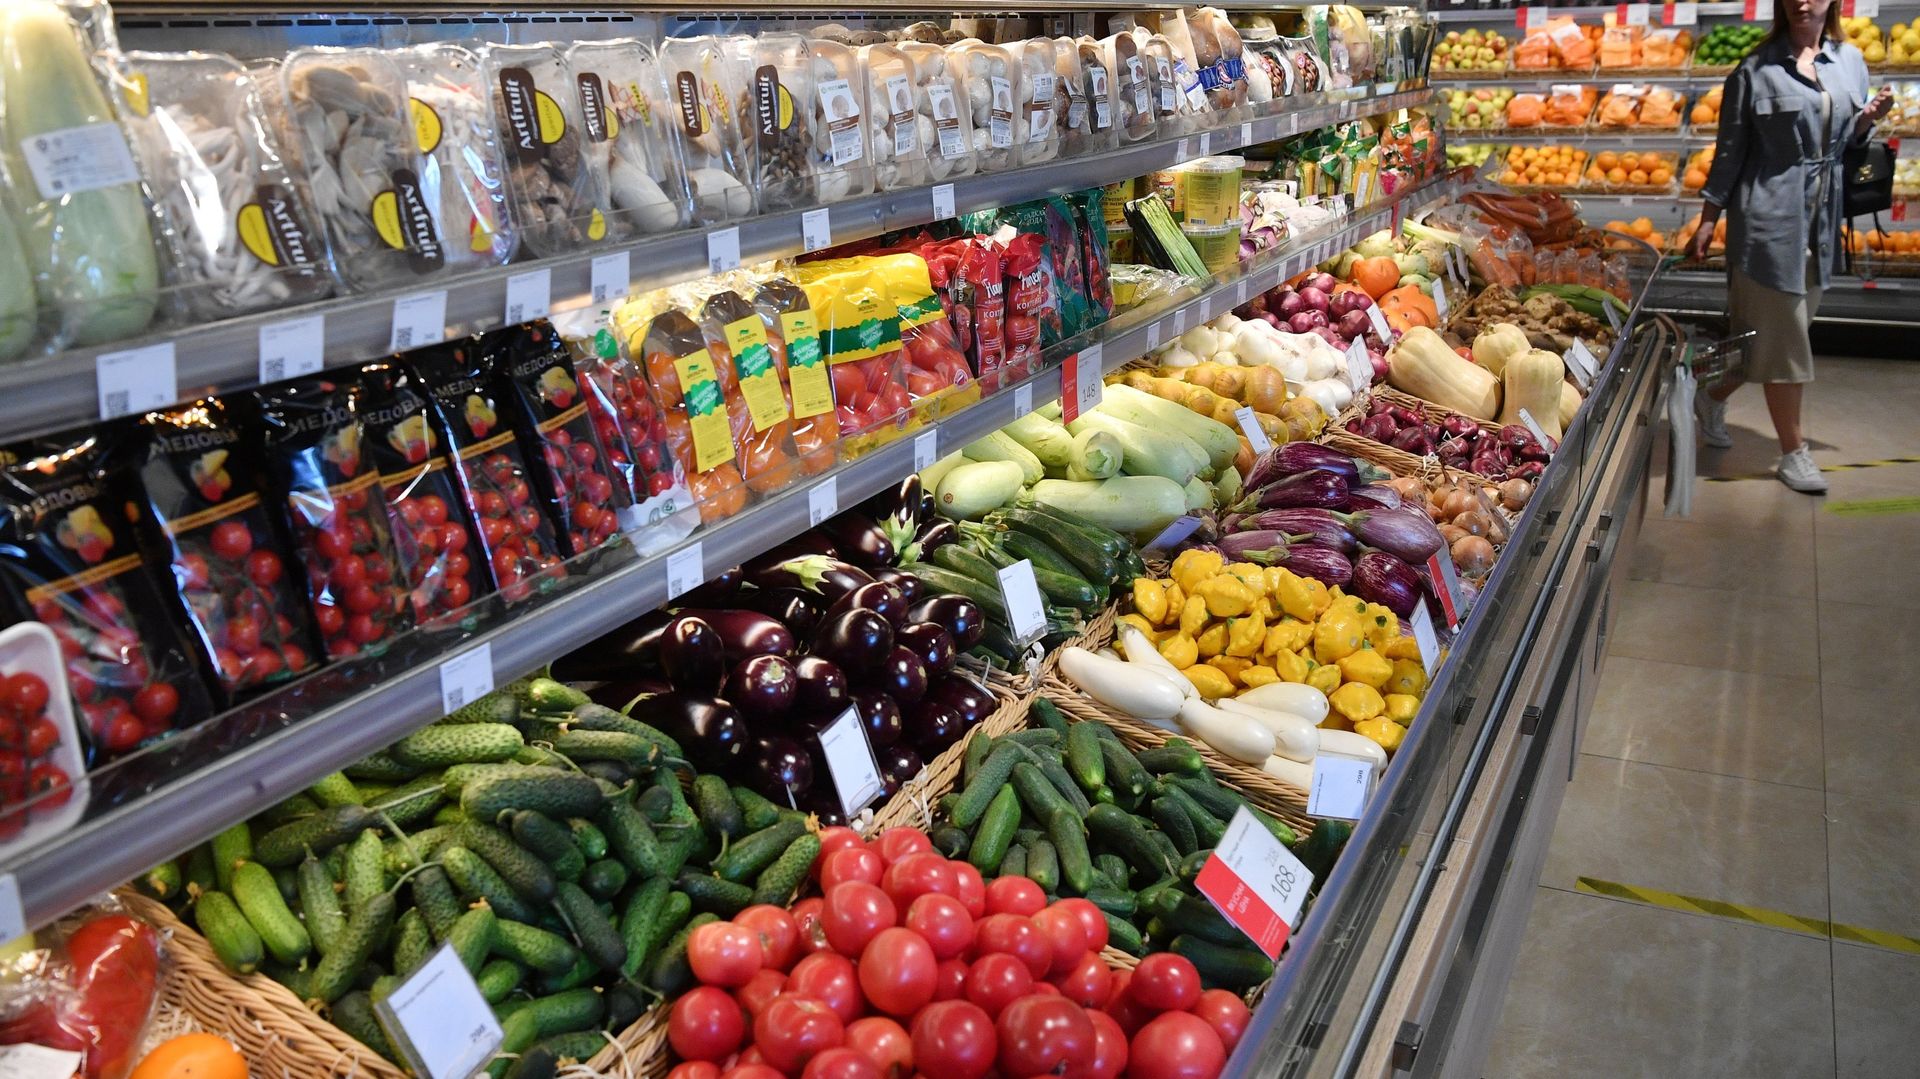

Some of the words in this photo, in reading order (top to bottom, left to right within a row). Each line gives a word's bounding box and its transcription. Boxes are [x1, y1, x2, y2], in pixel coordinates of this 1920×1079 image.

[506, 78, 535, 149] Artfruit
[582, 80, 600, 134] Artfruit
[680, 79, 698, 129] Artfruit
[757, 75, 774, 136] Artfruit
[269, 198, 316, 277] Artfruit
[399, 183, 438, 260] Artfruit
[1082, 383, 1096, 403] 148
[1271, 864, 1296, 904] 168
